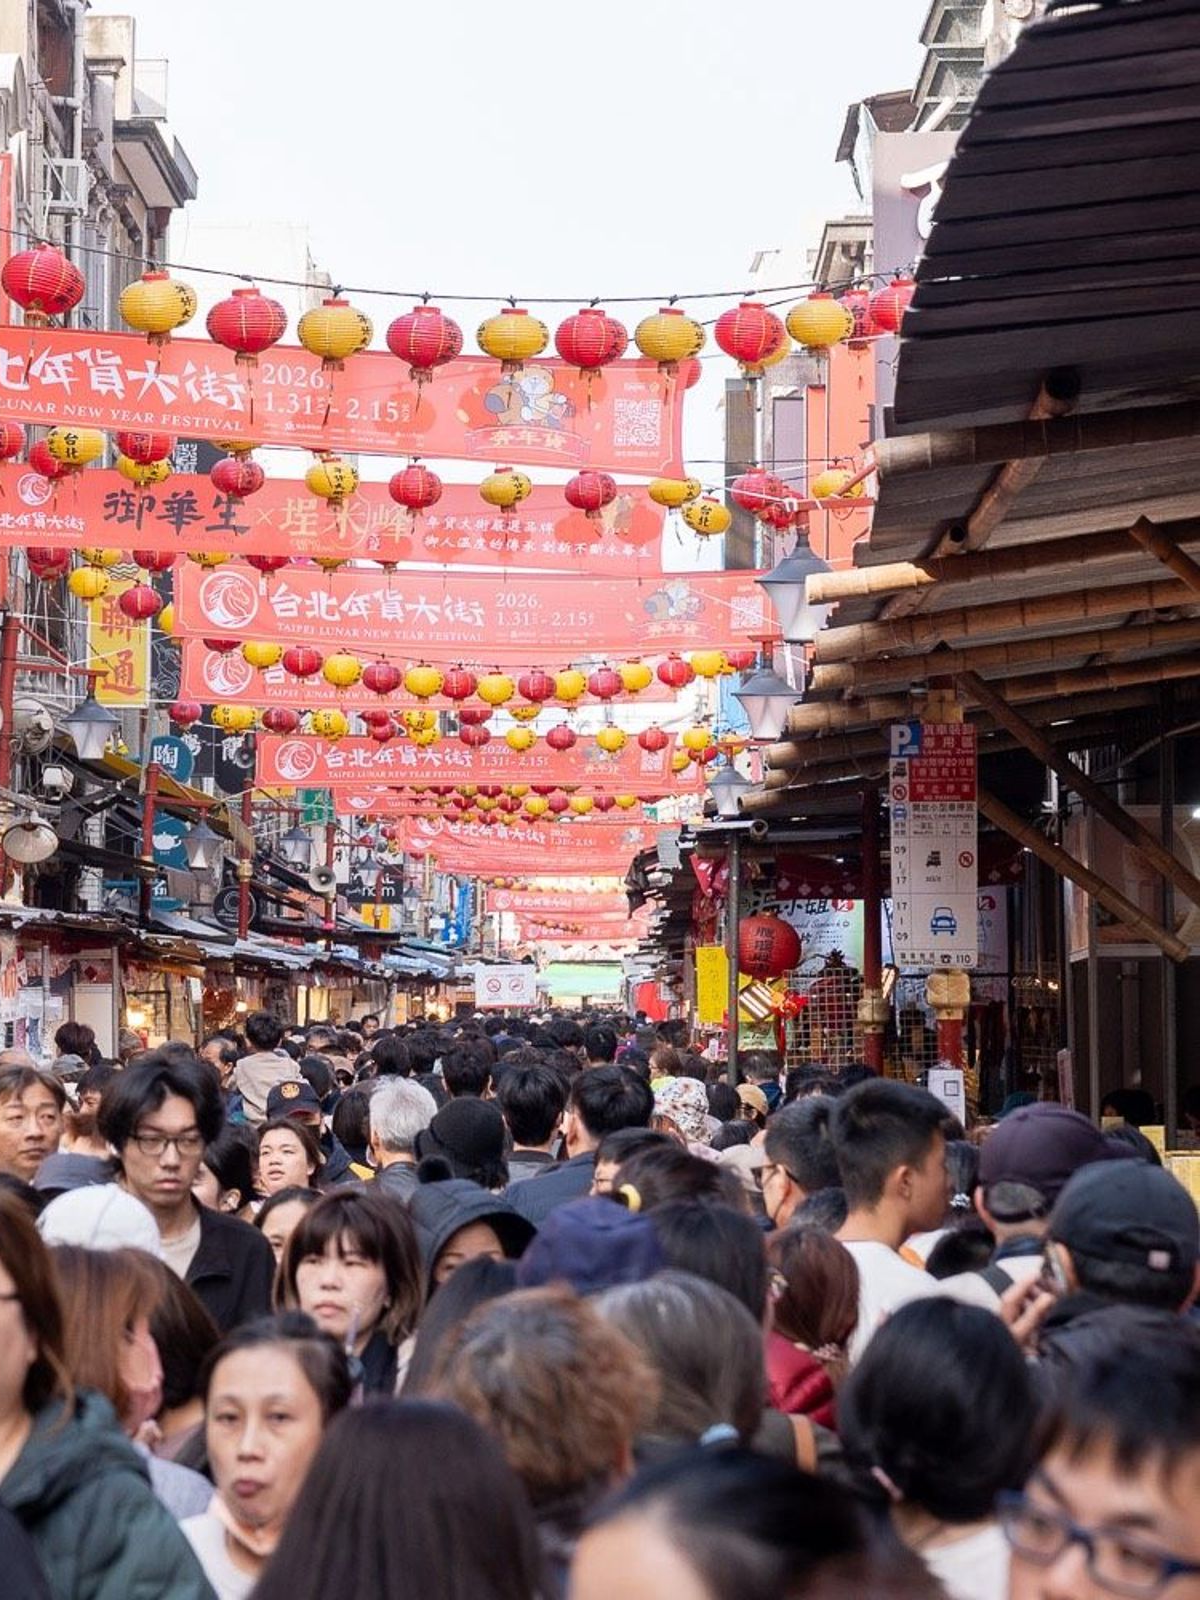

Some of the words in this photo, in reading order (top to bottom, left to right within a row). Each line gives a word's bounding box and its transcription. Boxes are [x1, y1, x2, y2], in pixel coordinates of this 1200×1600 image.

[64, 405, 101, 419] NEW
[110, 409, 155, 424] YEAR
[162, 414, 244, 431] FESTIVAL
[63, 432, 79, 459] 台北
[103, 490, 252, 536] 御華生
[698, 504, 711, 528] 台北
[269, 582, 485, 628] 台北年貨大街
[277, 622, 314, 635] TAIPEI
[319, 625, 359, 637] LUNAR
[364, 628, 391, 639] NEW
[394, 630, 425, 641] YEAR
[428, 631, 484, 642] FESTIVAL
[891, 724, 911, 755] P
[324, 745, 473, 768] 台北年貨大街
[896, 902, 907, 910] 17
[956, 954, 971, 964] 110
